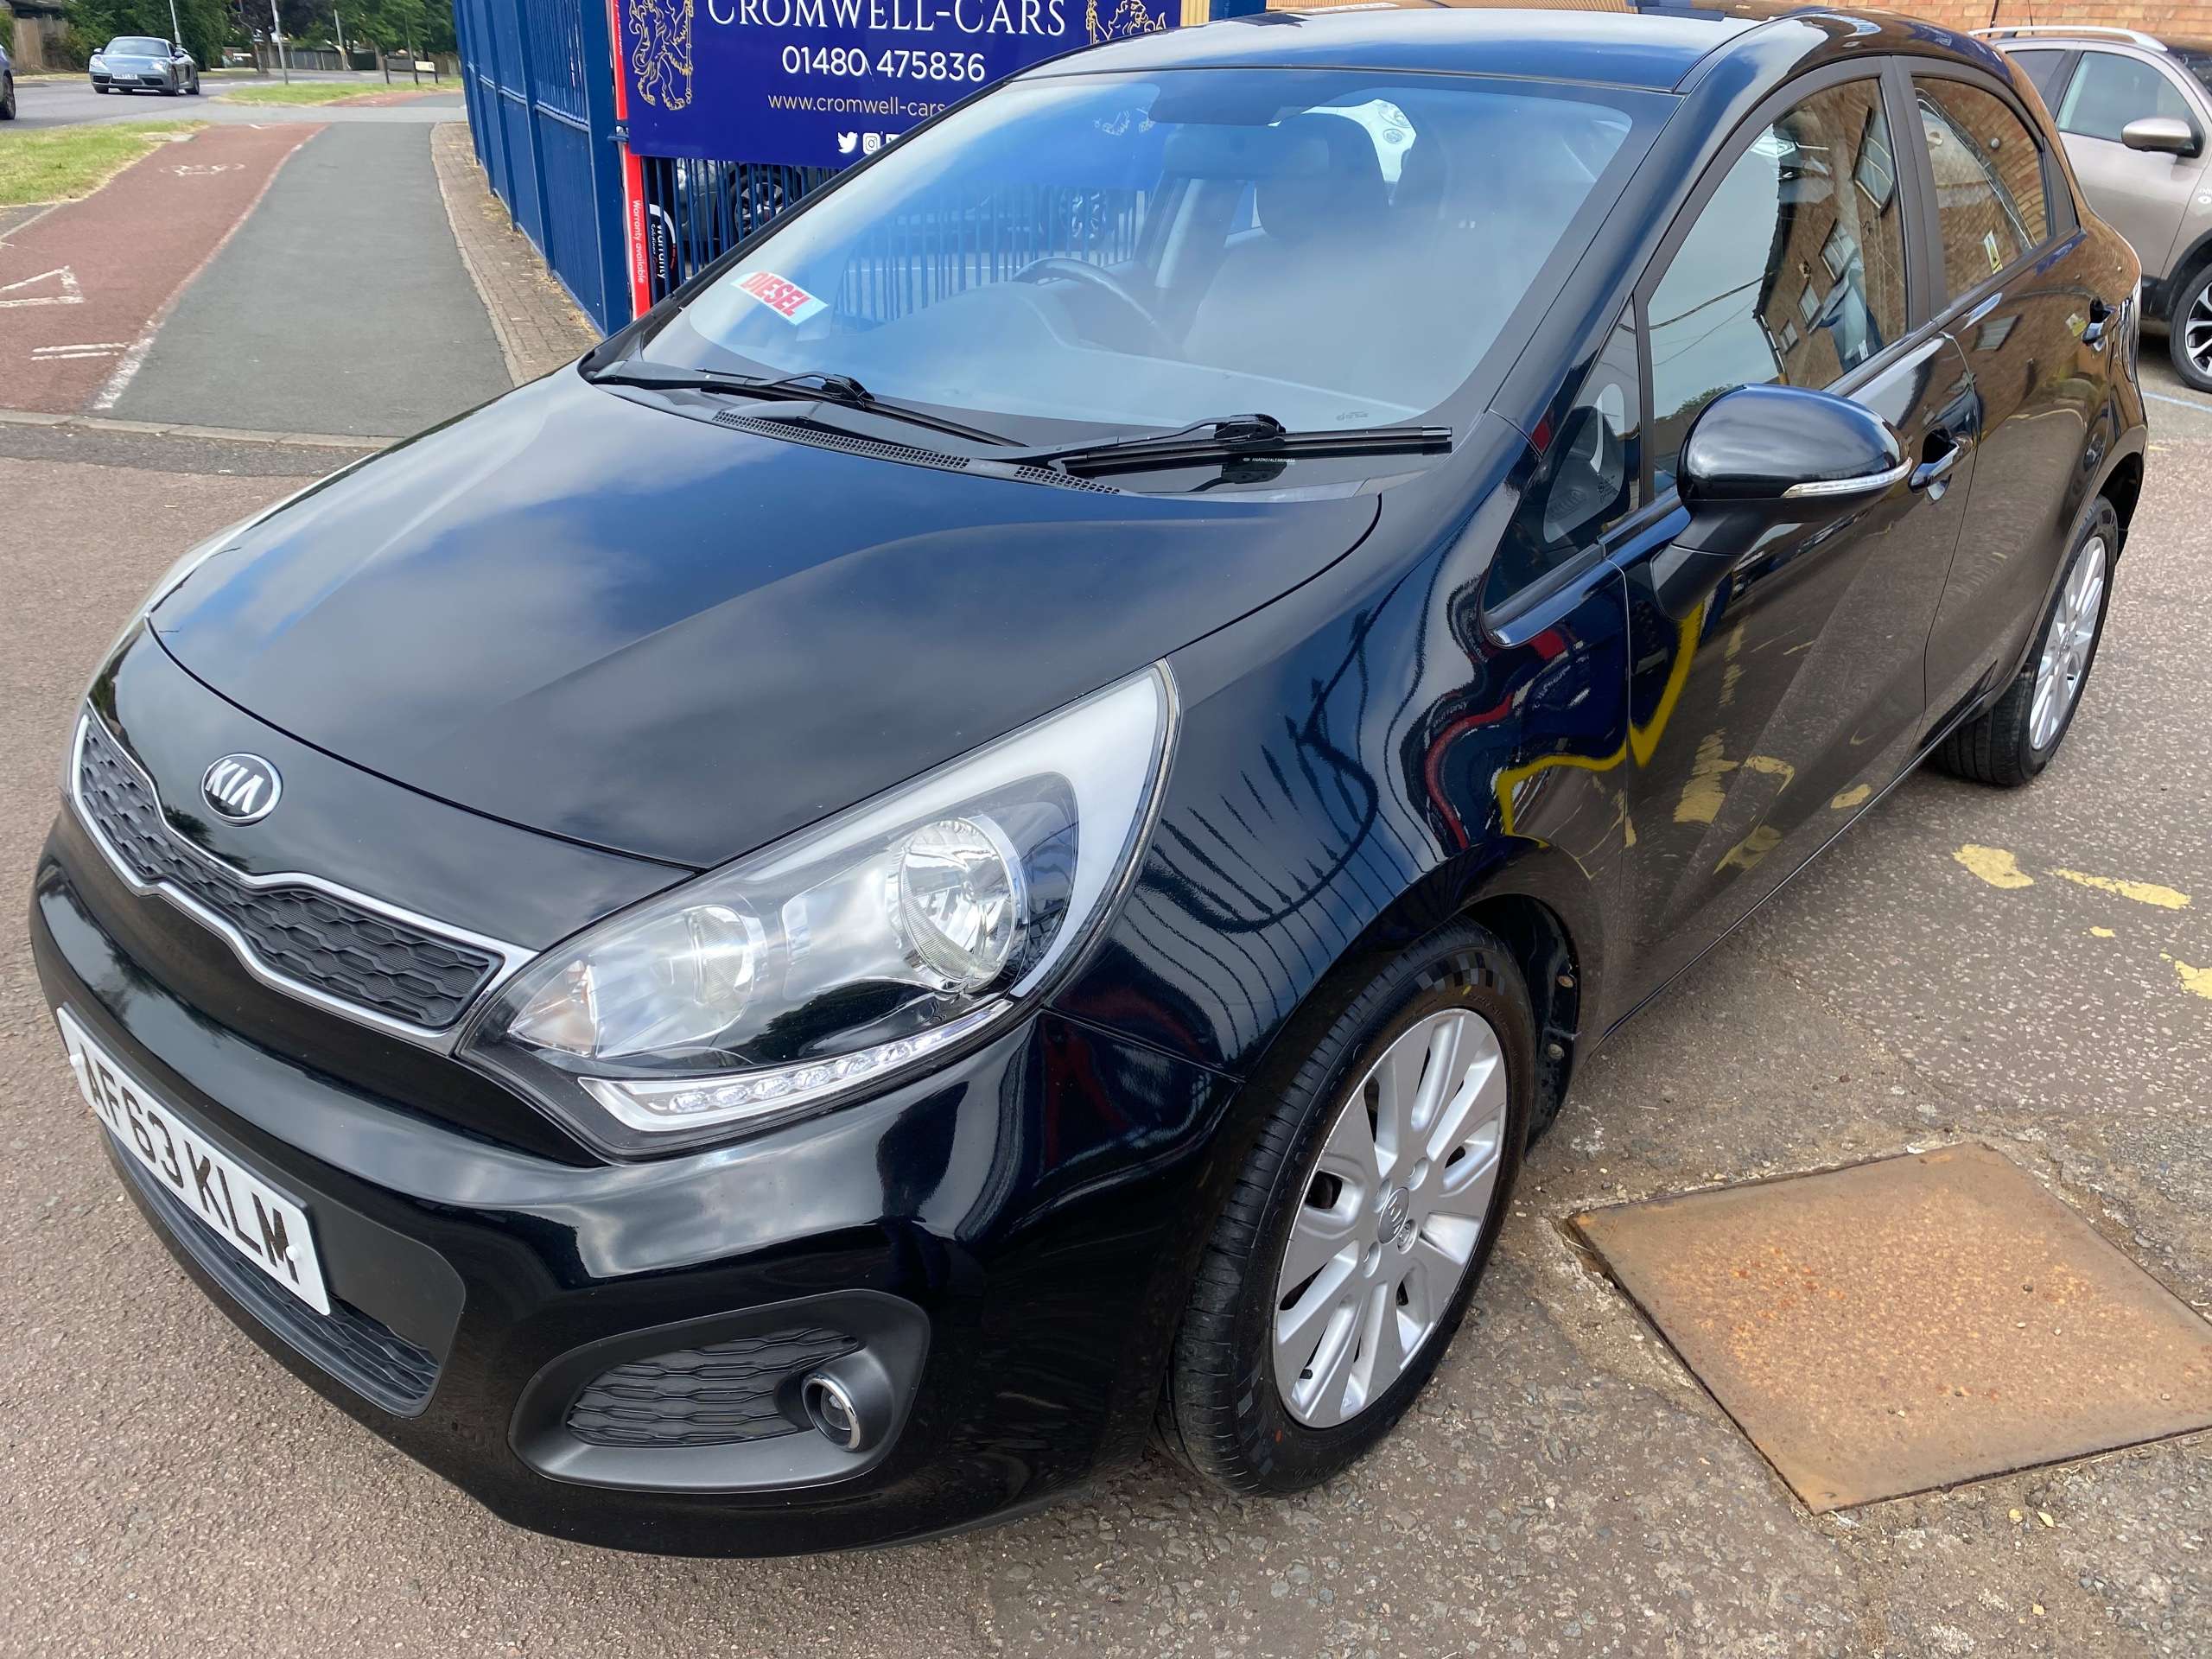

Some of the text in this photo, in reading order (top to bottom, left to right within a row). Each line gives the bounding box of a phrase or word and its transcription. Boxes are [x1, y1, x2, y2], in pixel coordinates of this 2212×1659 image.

[708, 0, 1066, 36] CROMWELL-CARS
[781, 45, 986, 82] 01480 475836
[632, 199, 645, 283] Warranty available
[739, 271, 811, 316] DIESEL
[204, 759, 265, 814] KIA
